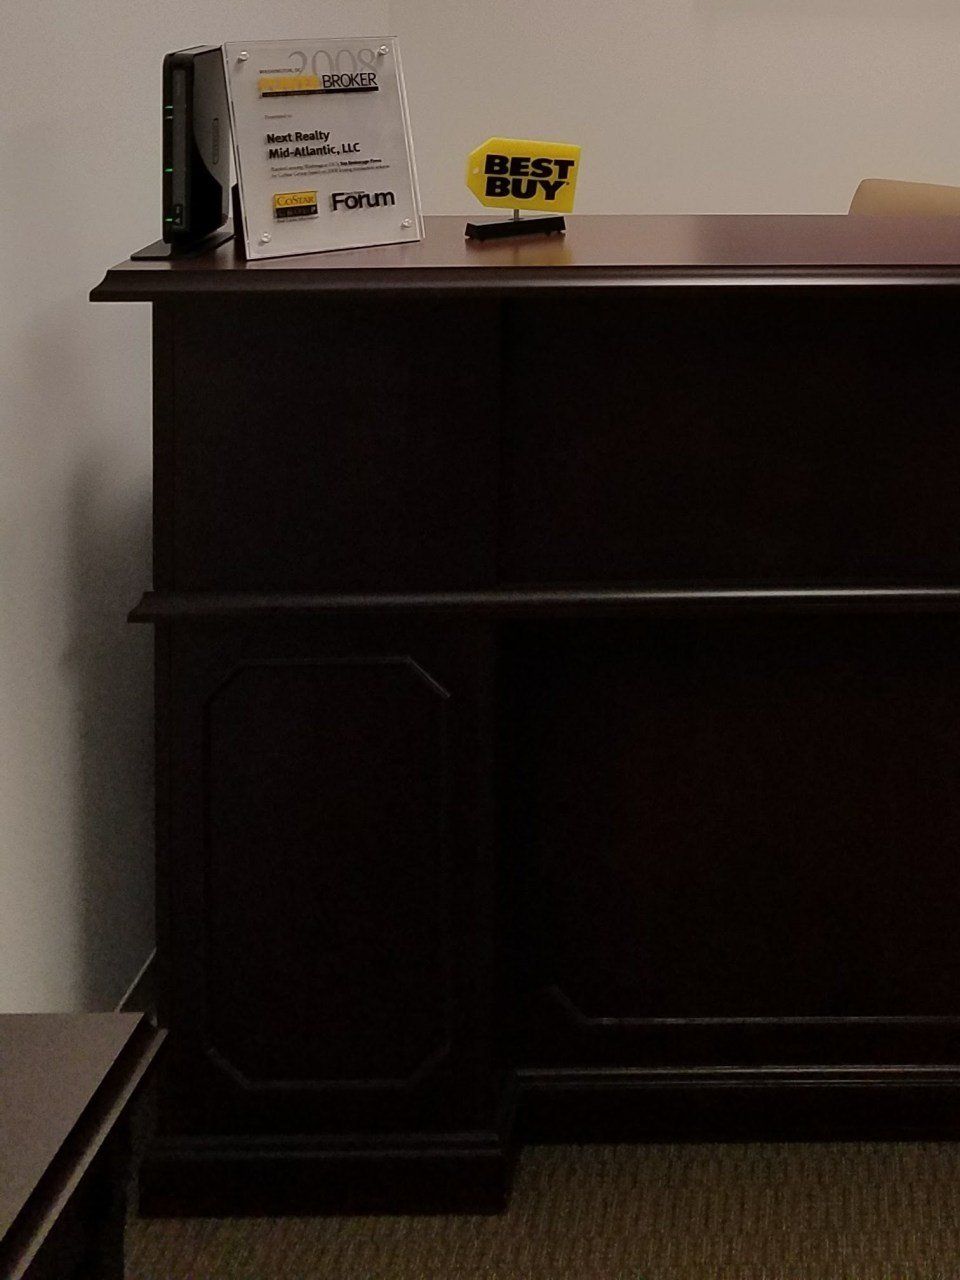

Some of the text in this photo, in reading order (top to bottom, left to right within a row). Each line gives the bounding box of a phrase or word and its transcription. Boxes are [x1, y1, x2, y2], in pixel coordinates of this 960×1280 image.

[288, 47, 377, 75] 2008
[322, 72, 378, 88] BROKER
[266, 130, 330, 144] Next Realty
[268, 142, 361, 159] Mid-Atlantic, LLC
[484, 154, 575, 180] BEST
[485, 177, 566, 201] BUY
[331, 191, 395, 211] Forum
